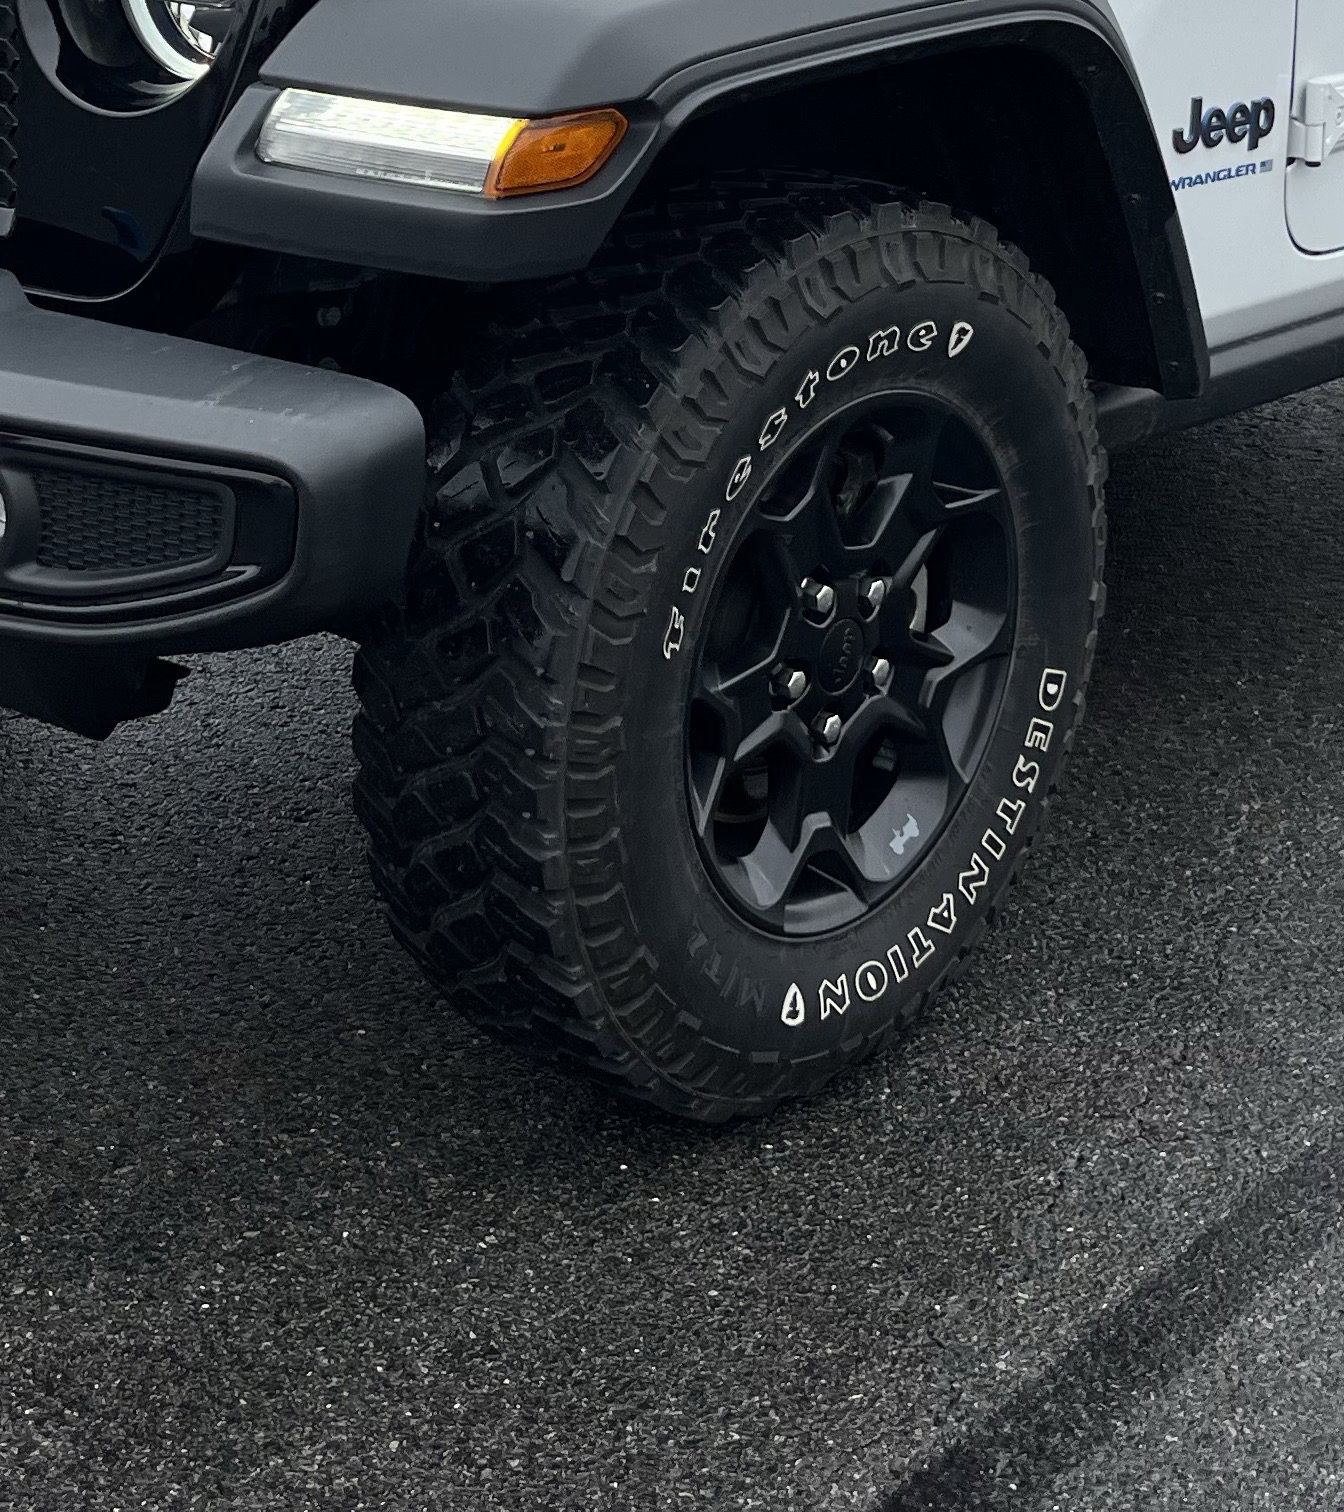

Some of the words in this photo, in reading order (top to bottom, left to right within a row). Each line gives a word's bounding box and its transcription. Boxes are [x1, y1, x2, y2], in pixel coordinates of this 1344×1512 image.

[1172, 96, 1275, 154] Jeep
[663, 319, 938, 660] Firestone
[819, 668, 1067, 1020] DESTINATION
